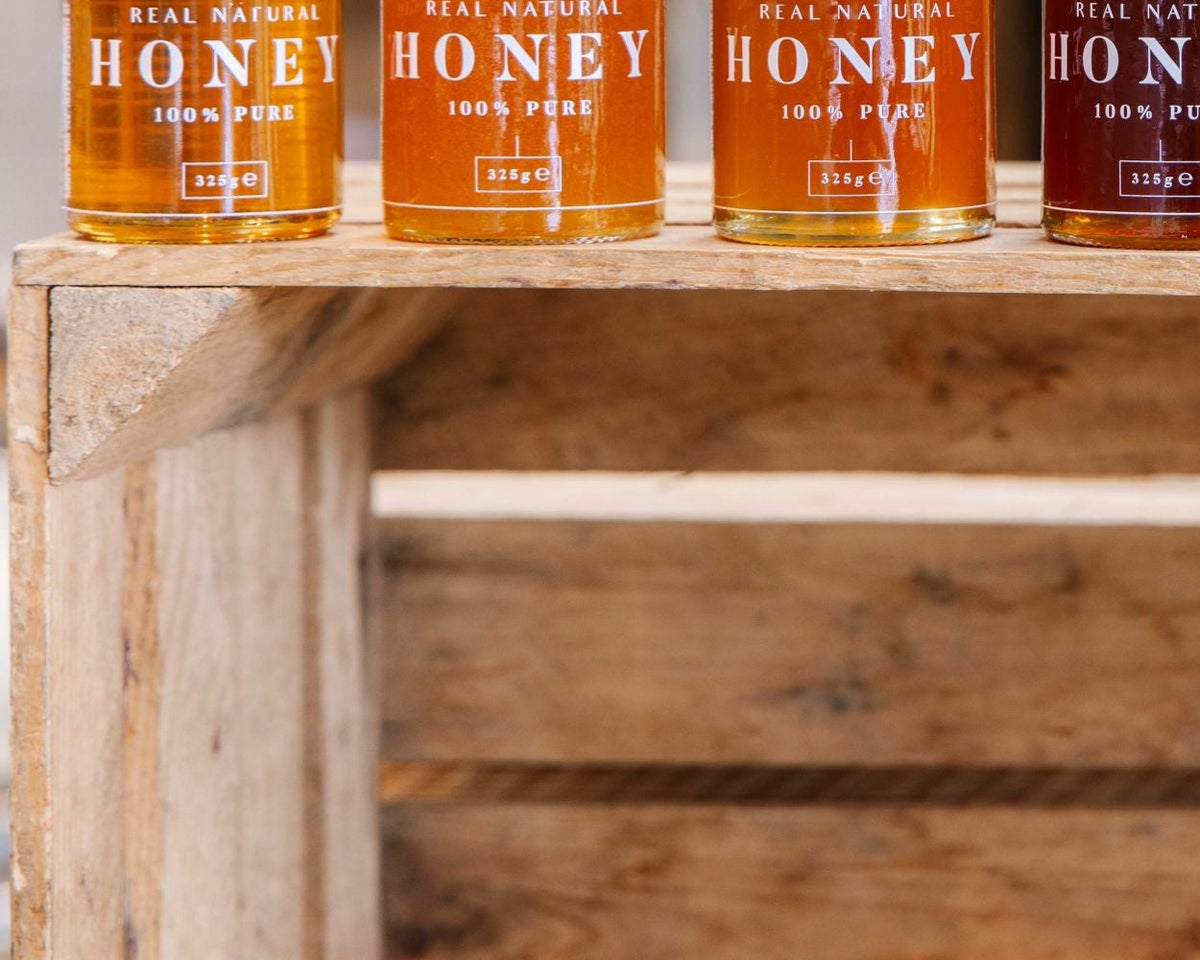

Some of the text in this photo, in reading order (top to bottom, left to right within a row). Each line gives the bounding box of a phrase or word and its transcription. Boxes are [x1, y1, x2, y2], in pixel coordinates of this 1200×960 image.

[129, 4, 320, 24] REAL NATURAL
[426, 0, 487, 17] REAL
[759, 1, 955, 20] REAL NATURAL
[1076, 2, 1131, 20] REAL
[90, 35, 339, 88] HONEY
[394, 29, 649, 81] HONEY
[727, 32, 981, 85] HONEY
[153, 104, 294, 123] 100% PURE
[448, 99, 592, 116] 100% PURE
[782, 103, 925, 120] 100% PURE
[1094, 103, 1153, 120] 100%
